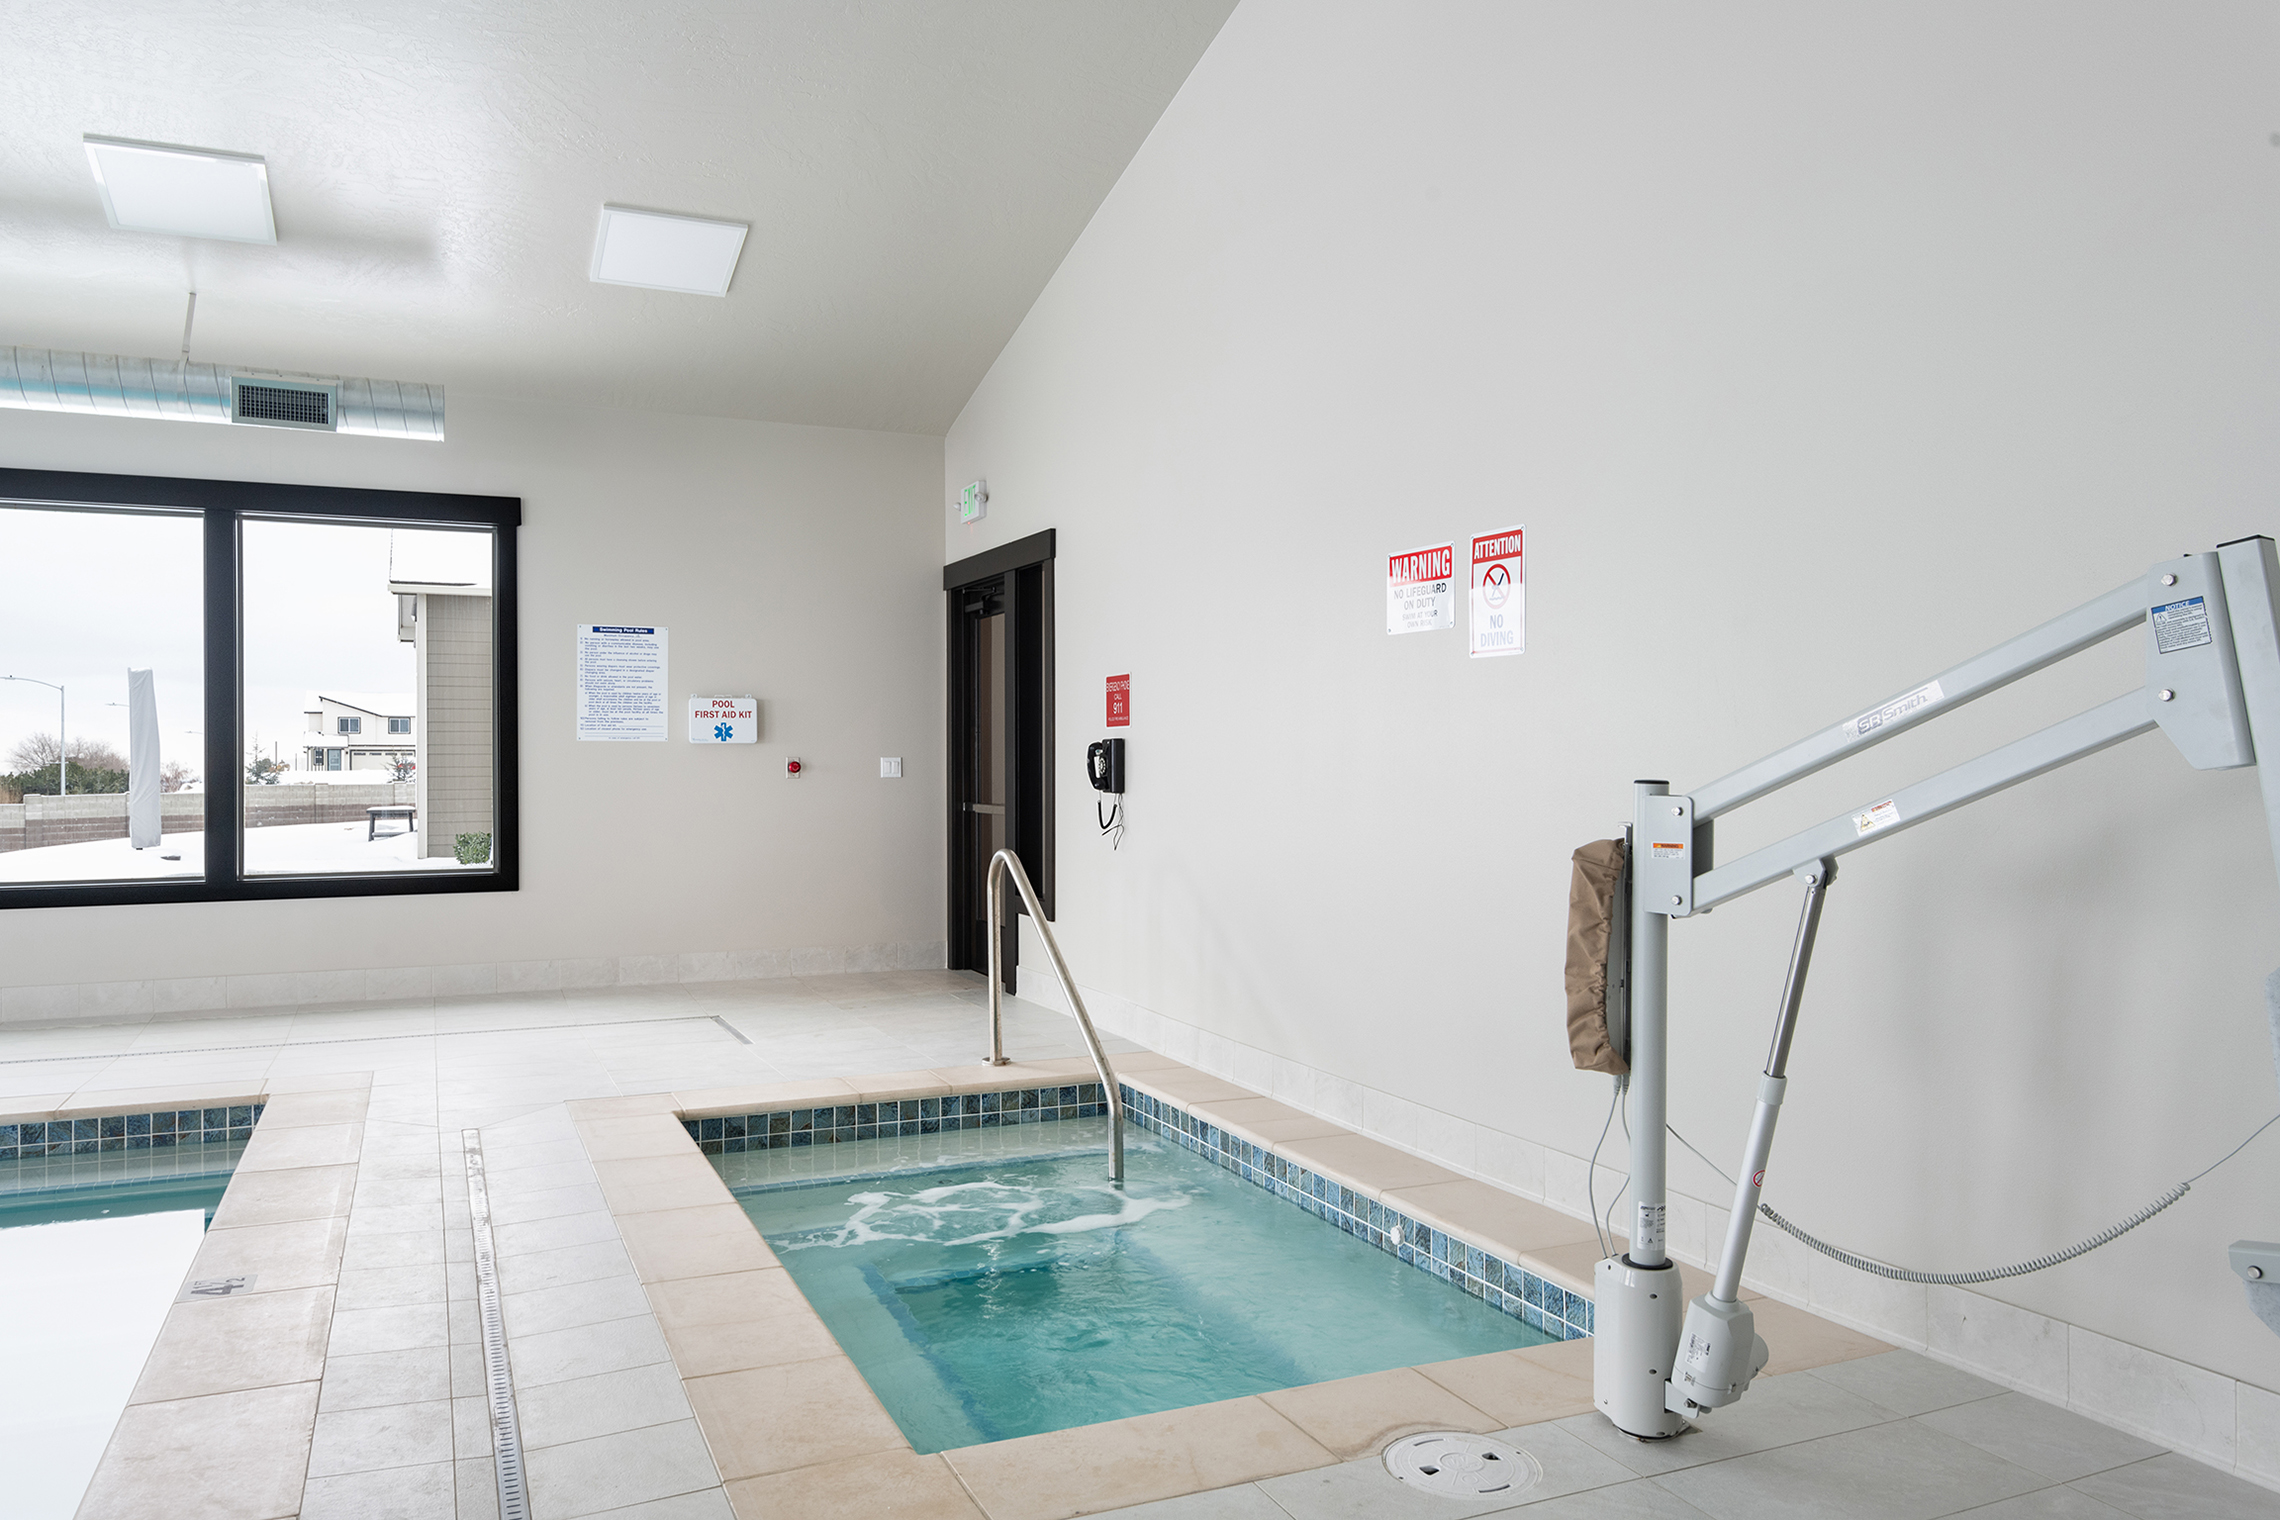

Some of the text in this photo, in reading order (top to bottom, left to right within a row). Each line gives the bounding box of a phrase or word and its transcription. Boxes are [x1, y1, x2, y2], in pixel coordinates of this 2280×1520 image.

[1474, 534, 1521, 560] ATTENTION
[1391, 549, 1450, 584] WARNING
[1394, 582, 1447, 600] NO LIFEGUARD
[1403, 597, 1436, 611] ON DUTY
[1489, 613, 1504, 629] NO
[1480, 630, 1514, 648] DIVING
[712, 700, 735, 708] POOL
[1113, 702, 1123, 714] 911
[694, 710, 752, 719] FIRST AID KIT
